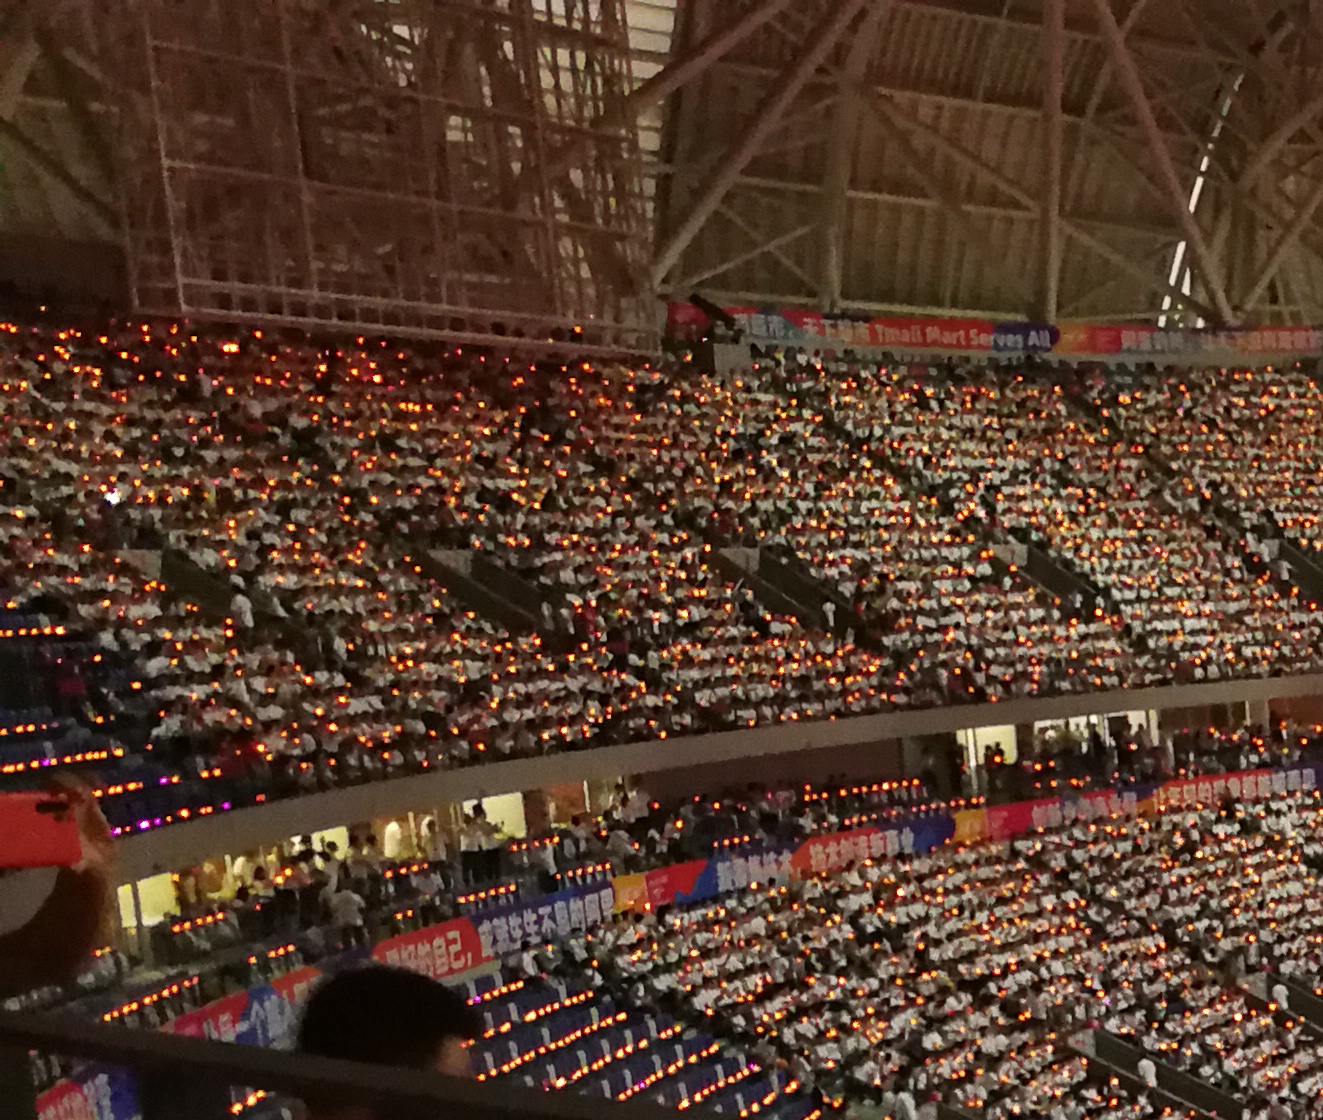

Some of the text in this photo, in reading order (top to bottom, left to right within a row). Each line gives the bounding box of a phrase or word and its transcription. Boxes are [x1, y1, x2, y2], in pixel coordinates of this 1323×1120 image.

[874, 323, 923, 343] Tmall
[925, 324, 966, 345] Mart
[969, 327, 1024, 348] Serves
[1027, 329, 1051, 348] All
